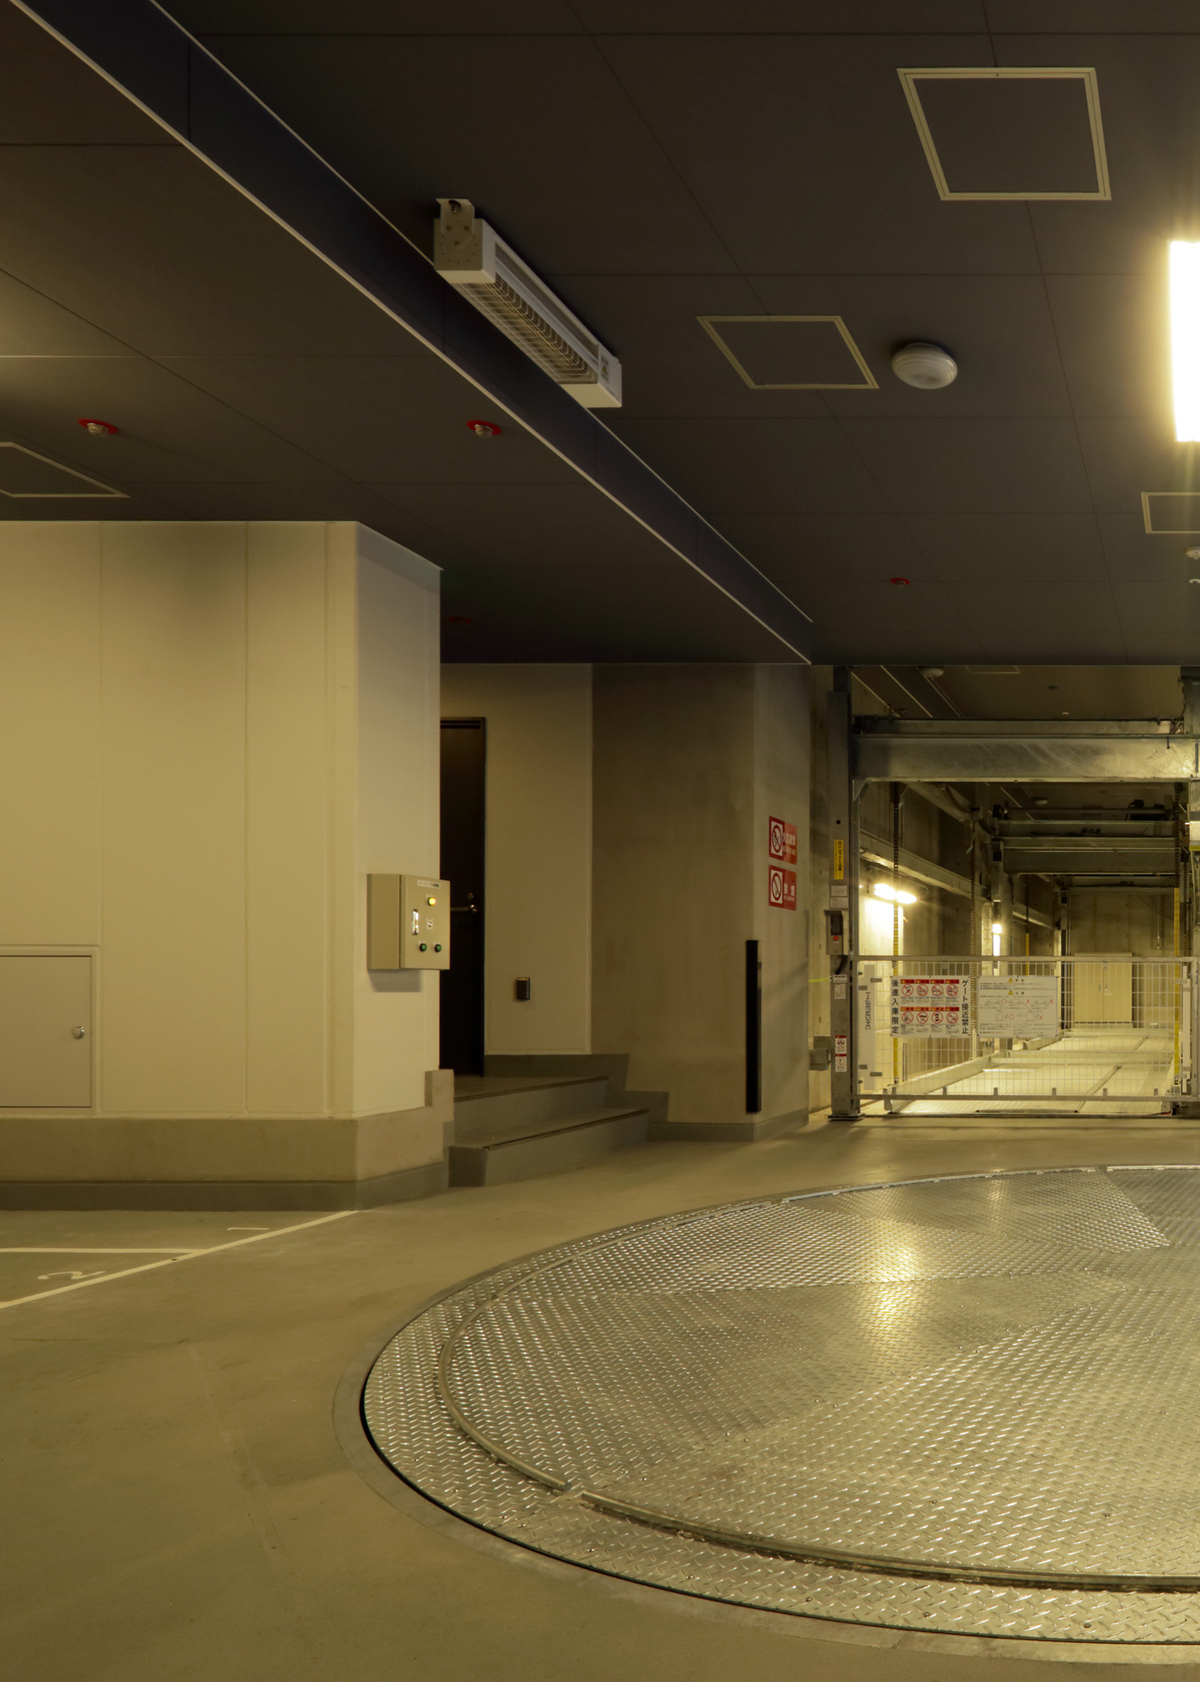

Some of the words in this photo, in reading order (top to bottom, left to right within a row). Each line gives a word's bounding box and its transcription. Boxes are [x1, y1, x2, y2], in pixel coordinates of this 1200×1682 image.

[891, 979, 900, 1034] 後進入庫限定
[961, 979, 969, 1035] ゲート接近禁止
[37, 1271, 106, 1280] 2
